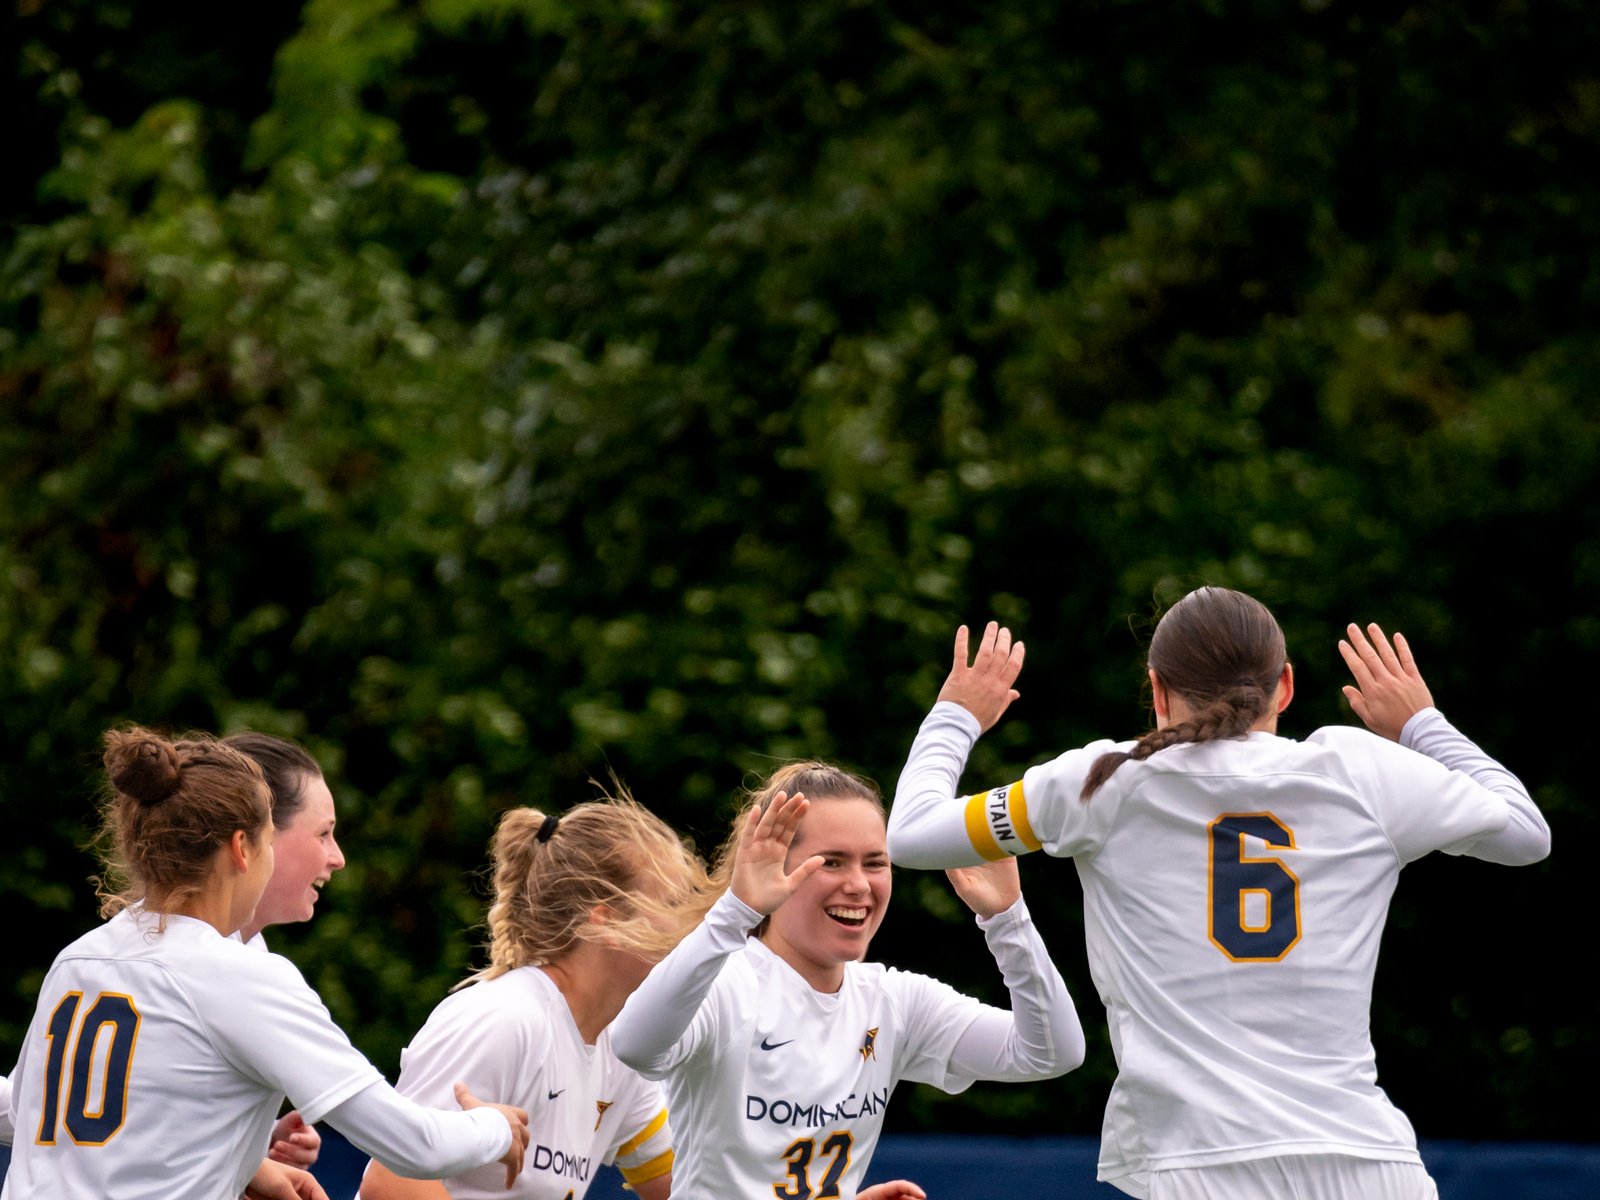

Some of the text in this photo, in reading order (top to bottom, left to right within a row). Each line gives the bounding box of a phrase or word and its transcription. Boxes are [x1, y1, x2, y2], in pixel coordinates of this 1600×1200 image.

[1206, 811, 1302, 963] 6
[34, 990, 142, 1147] 10
[746, 1087, 888, 1128] DOMINICAN
